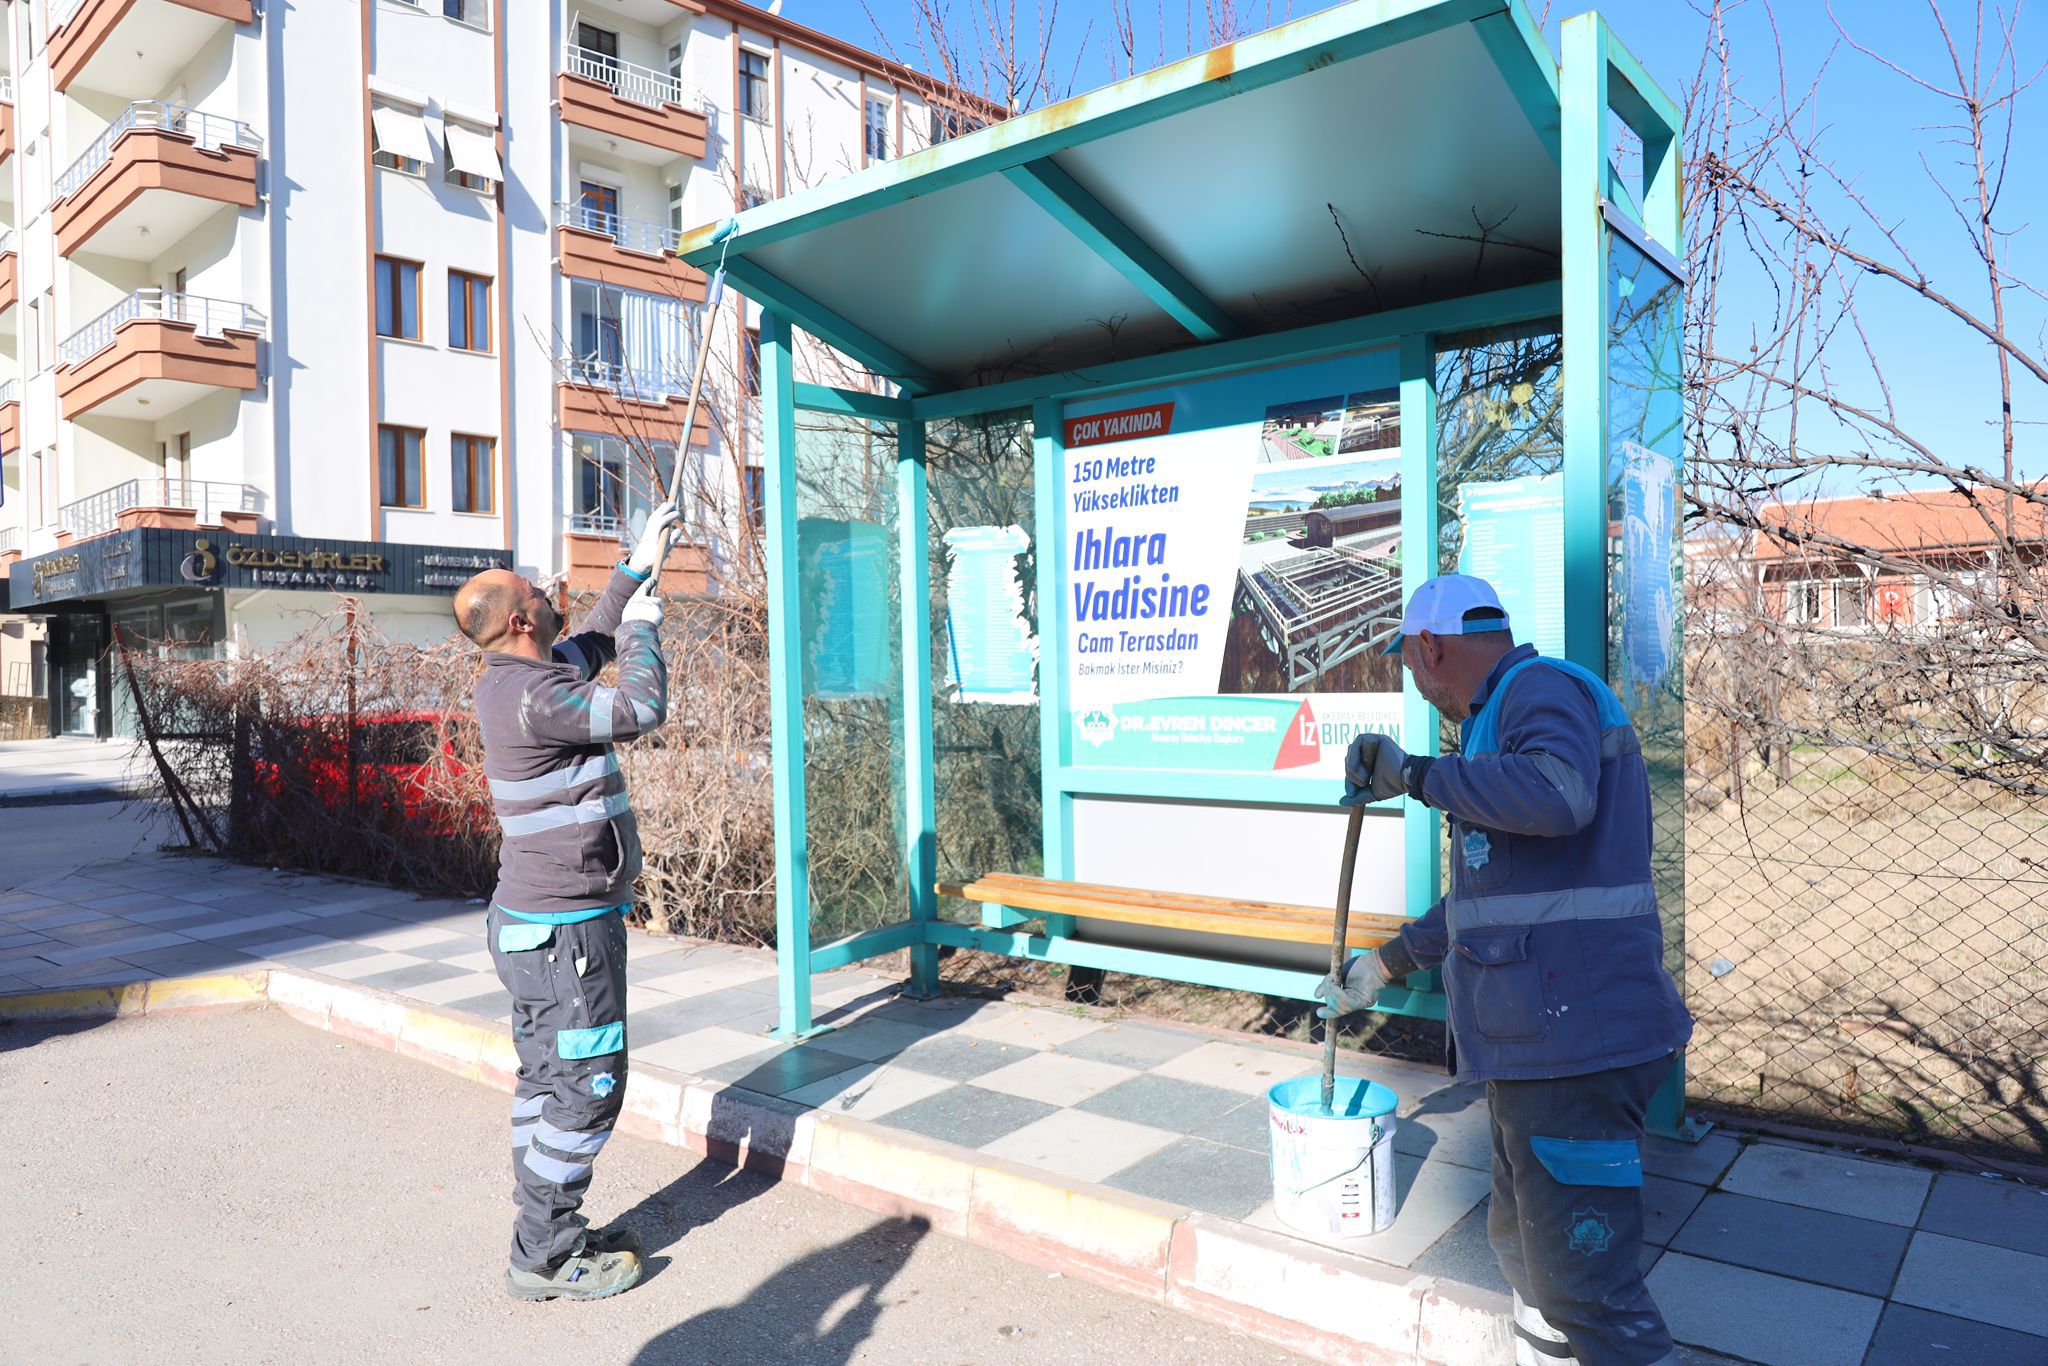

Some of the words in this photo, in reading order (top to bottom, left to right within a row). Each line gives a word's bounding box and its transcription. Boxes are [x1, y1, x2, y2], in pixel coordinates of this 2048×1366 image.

[1073, 421, 1100, 445] ÇOK
[1103, 411, 1162, 436] YAKINDA
[1073, 459, 1102, 483] 150
[1106, 455, 1156, 479] Metre
[1073, 483, 1179, 513] Yükseklikten
[226, 542, 384, 571] ÖZDEMİRLER
[1074, 526, 1167, 571] Ihlara
[1074, 572, 1210, 622] Vadisine
[1078, 632, 1114, 653] Cam
[1119, 628, 1199, 653] Terasdan
[1078, 662, 1115, 675] Bakmak
[1143, 660, 1184, 675] Misiniz?
